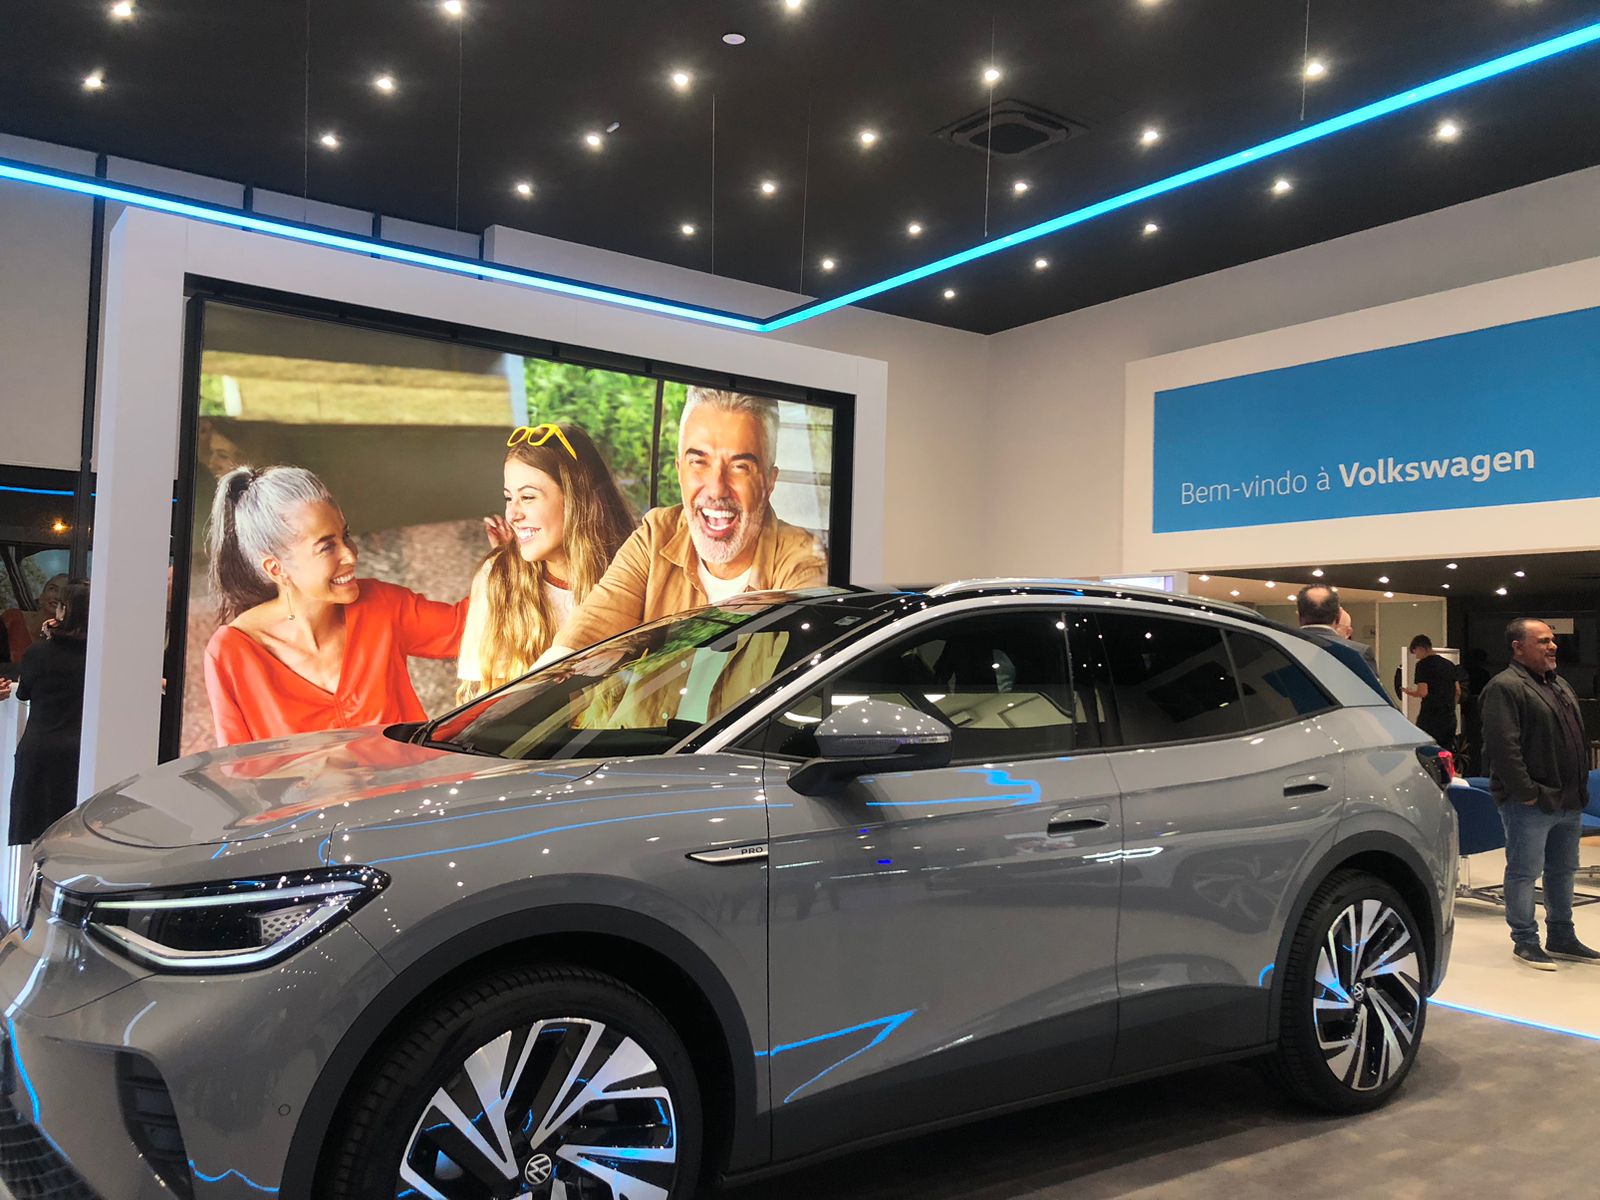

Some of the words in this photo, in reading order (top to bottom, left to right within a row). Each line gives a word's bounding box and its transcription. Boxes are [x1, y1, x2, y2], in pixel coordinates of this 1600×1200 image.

[1181, 470, 1308, 505] Bem-vindo
[1316, 466, 1331, 491] à
[1338, 448, 1535, 488] Volkswagen
[741, 846, 764, 855] PRO
